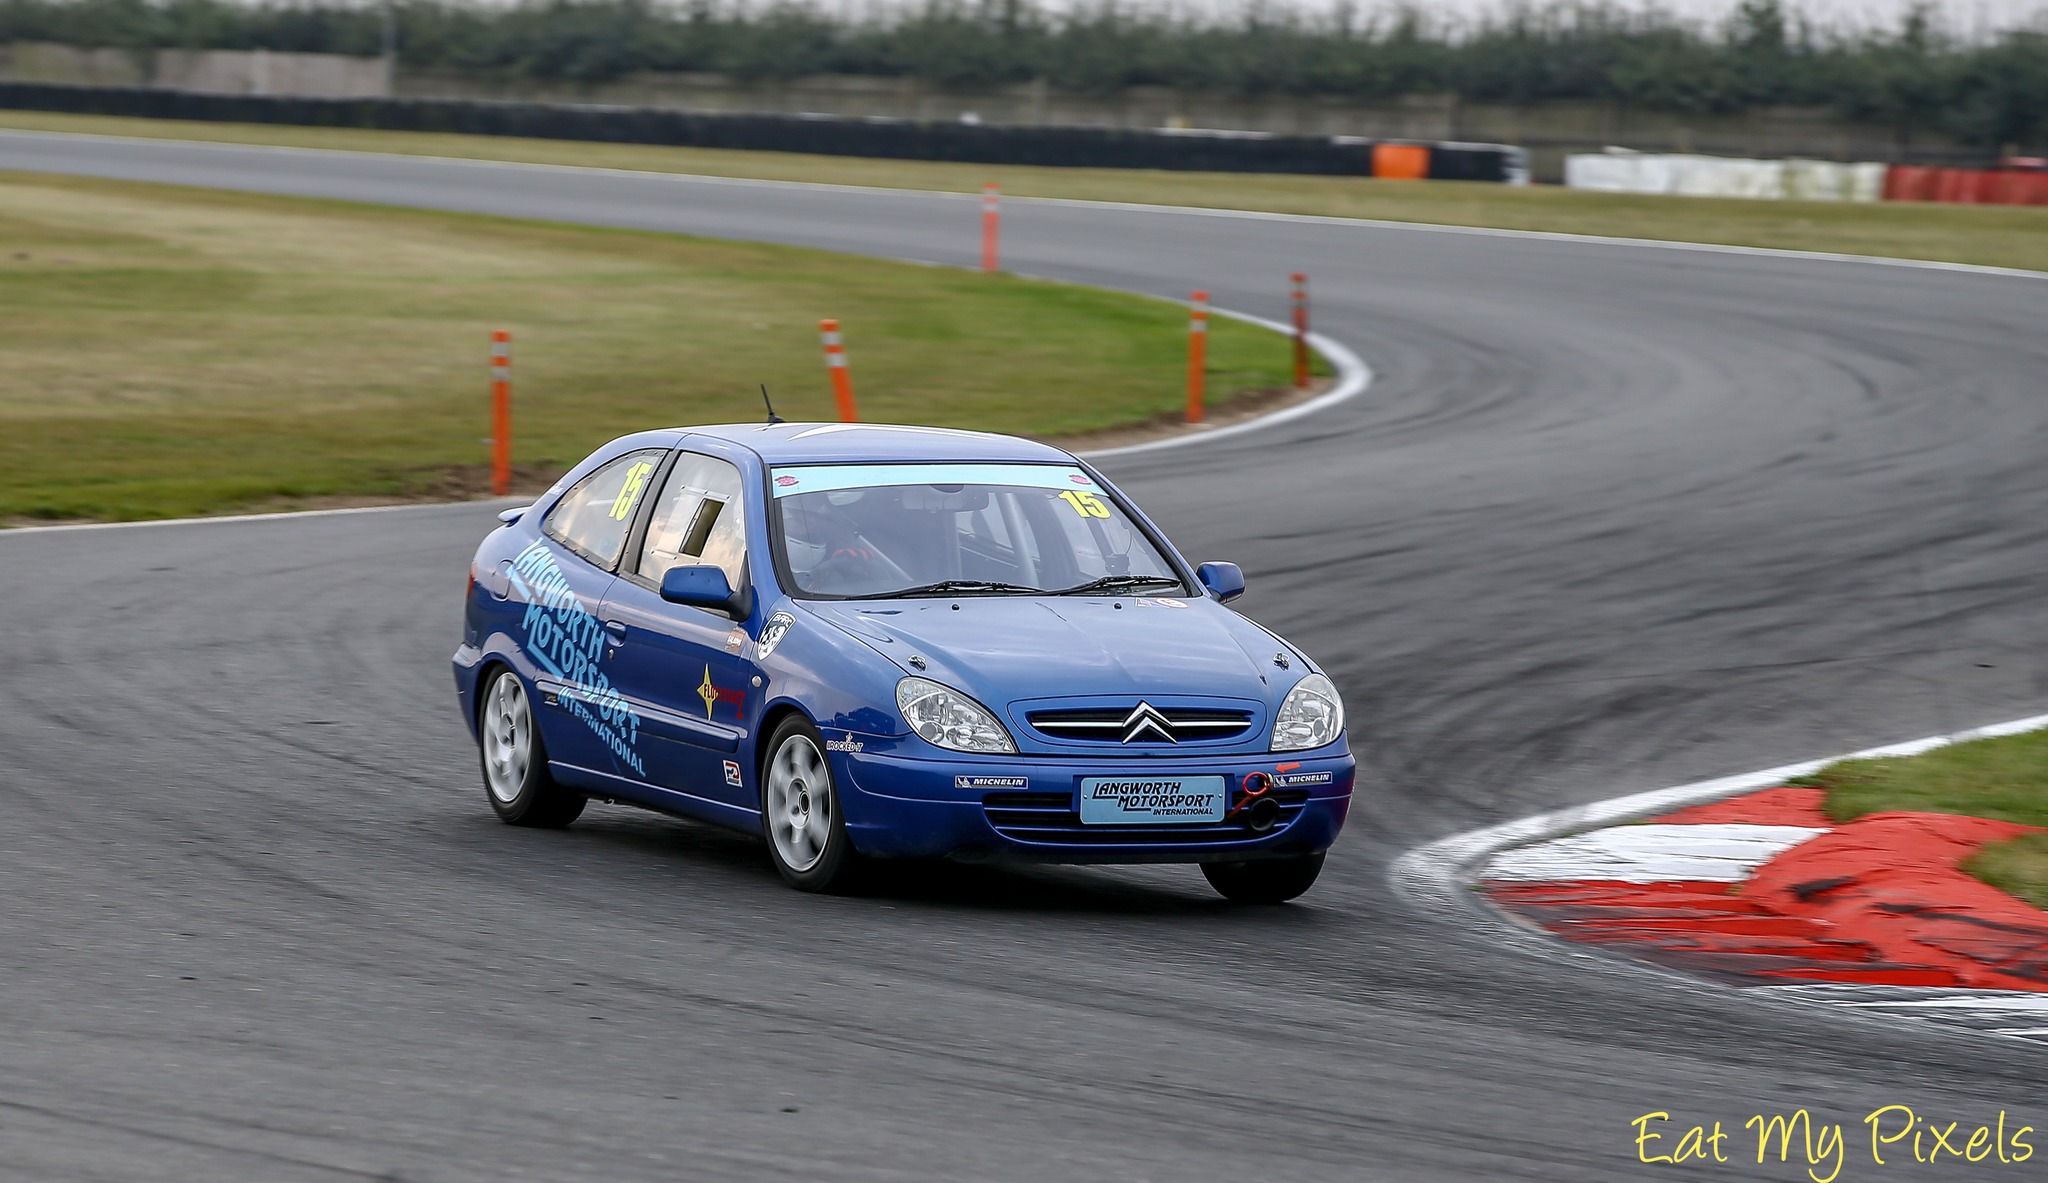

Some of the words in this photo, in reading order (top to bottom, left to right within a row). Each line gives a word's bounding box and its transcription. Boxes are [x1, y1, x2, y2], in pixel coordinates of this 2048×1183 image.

[608, 461, 653, 521] 15
[1058, 490, 1111, 519] 15
[506, 537, 606, 663] LANGWORTH
[522, 598, 641, 745] MOTORSPORT
[557, 686, 647, 777] INTERNATIONAL
[973, 777, 1025, 788] MICHELIN
[1092, 781, 1182, 799] LANGWORTH
[1288, 773, 1330, 784] MICHELIN
[1117, 794, 1216, 811] MOTORSPORT
[1152, 807, 1214, 816] INTERNATIONAL
